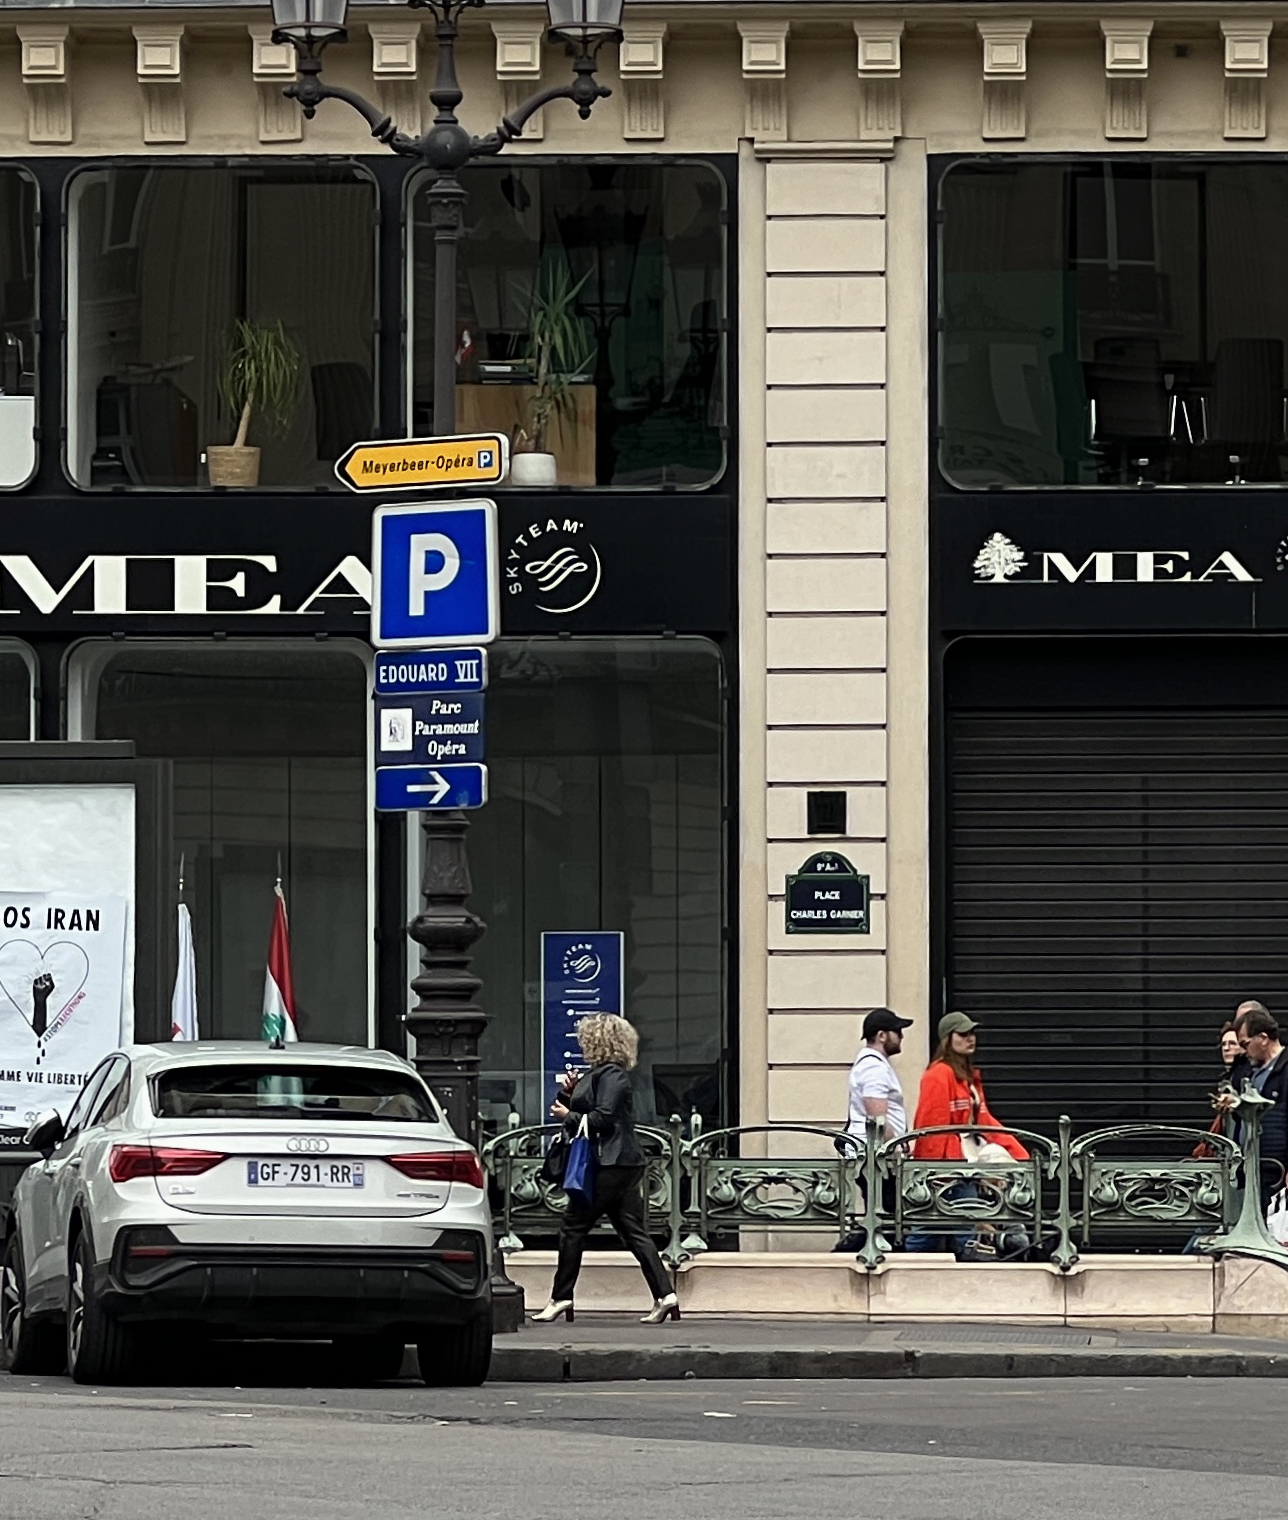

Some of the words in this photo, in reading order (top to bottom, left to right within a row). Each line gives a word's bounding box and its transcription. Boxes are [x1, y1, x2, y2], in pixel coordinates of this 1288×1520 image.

[362, 454, 474, 475] Meyerbeer-Opéra
[506, 519, 580, 594] SKYTEAM
[1033, 550, 1263, 583] MEA
[408, 532, 460, 616] P
[379, 662, 447, 683] EDOUARD
[454, 659, 480, 682] VII
[431, 700, 462, 714] Parc
[415, 719, 479, 735] Paramount
[428, 740, 466, 760] Opéra
[814, 891, 840, 900] PLACE
[46, 907, 100, 931] IRAN
[790, 910, 827, 919] CHARLES
[830, 910, 864, 919] GARNIER
[26, 1071, 44, 1083] VIE
[47, 1072, 89, 1086] LIBERTÉ
[260, 1163, 352, 1183] GF-791-RR
